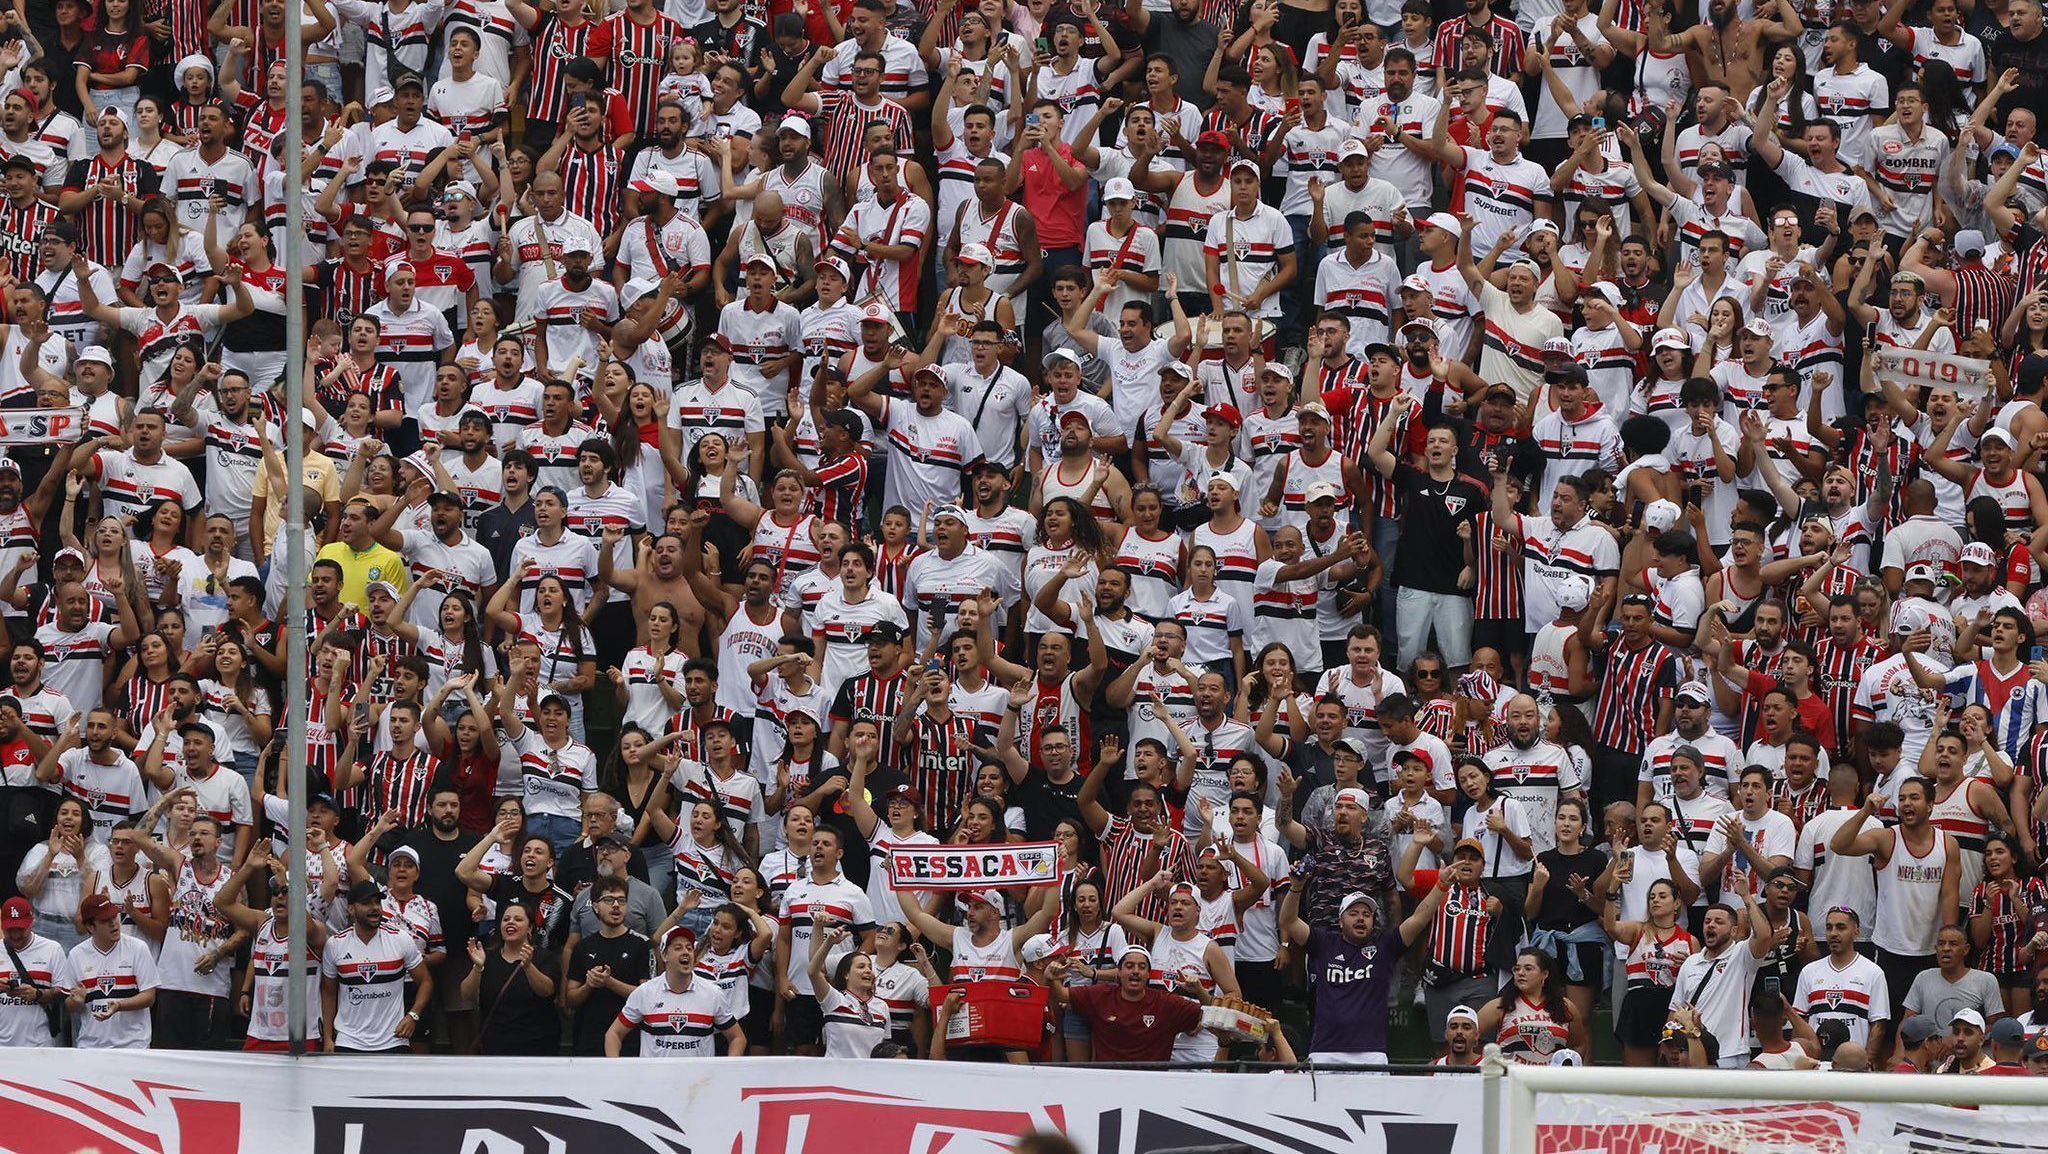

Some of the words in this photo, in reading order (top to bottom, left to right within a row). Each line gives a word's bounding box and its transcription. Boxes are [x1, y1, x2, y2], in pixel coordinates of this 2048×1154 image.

[1473, 197, 1518, 217] SUPERBET
[0, 233, 39, 255] nter
[739, 643, 763, 659] 1972
[919, 753, 967, 772] inter
[894, 854, 1018, 878] RESSACA
[1326, 965, 1375, 984] inter
[877, 978, 897, 991] LG
[1513, 1014, 1552, 1027] FALAN
[655, 1038, 701, 1051] SUPERBET
